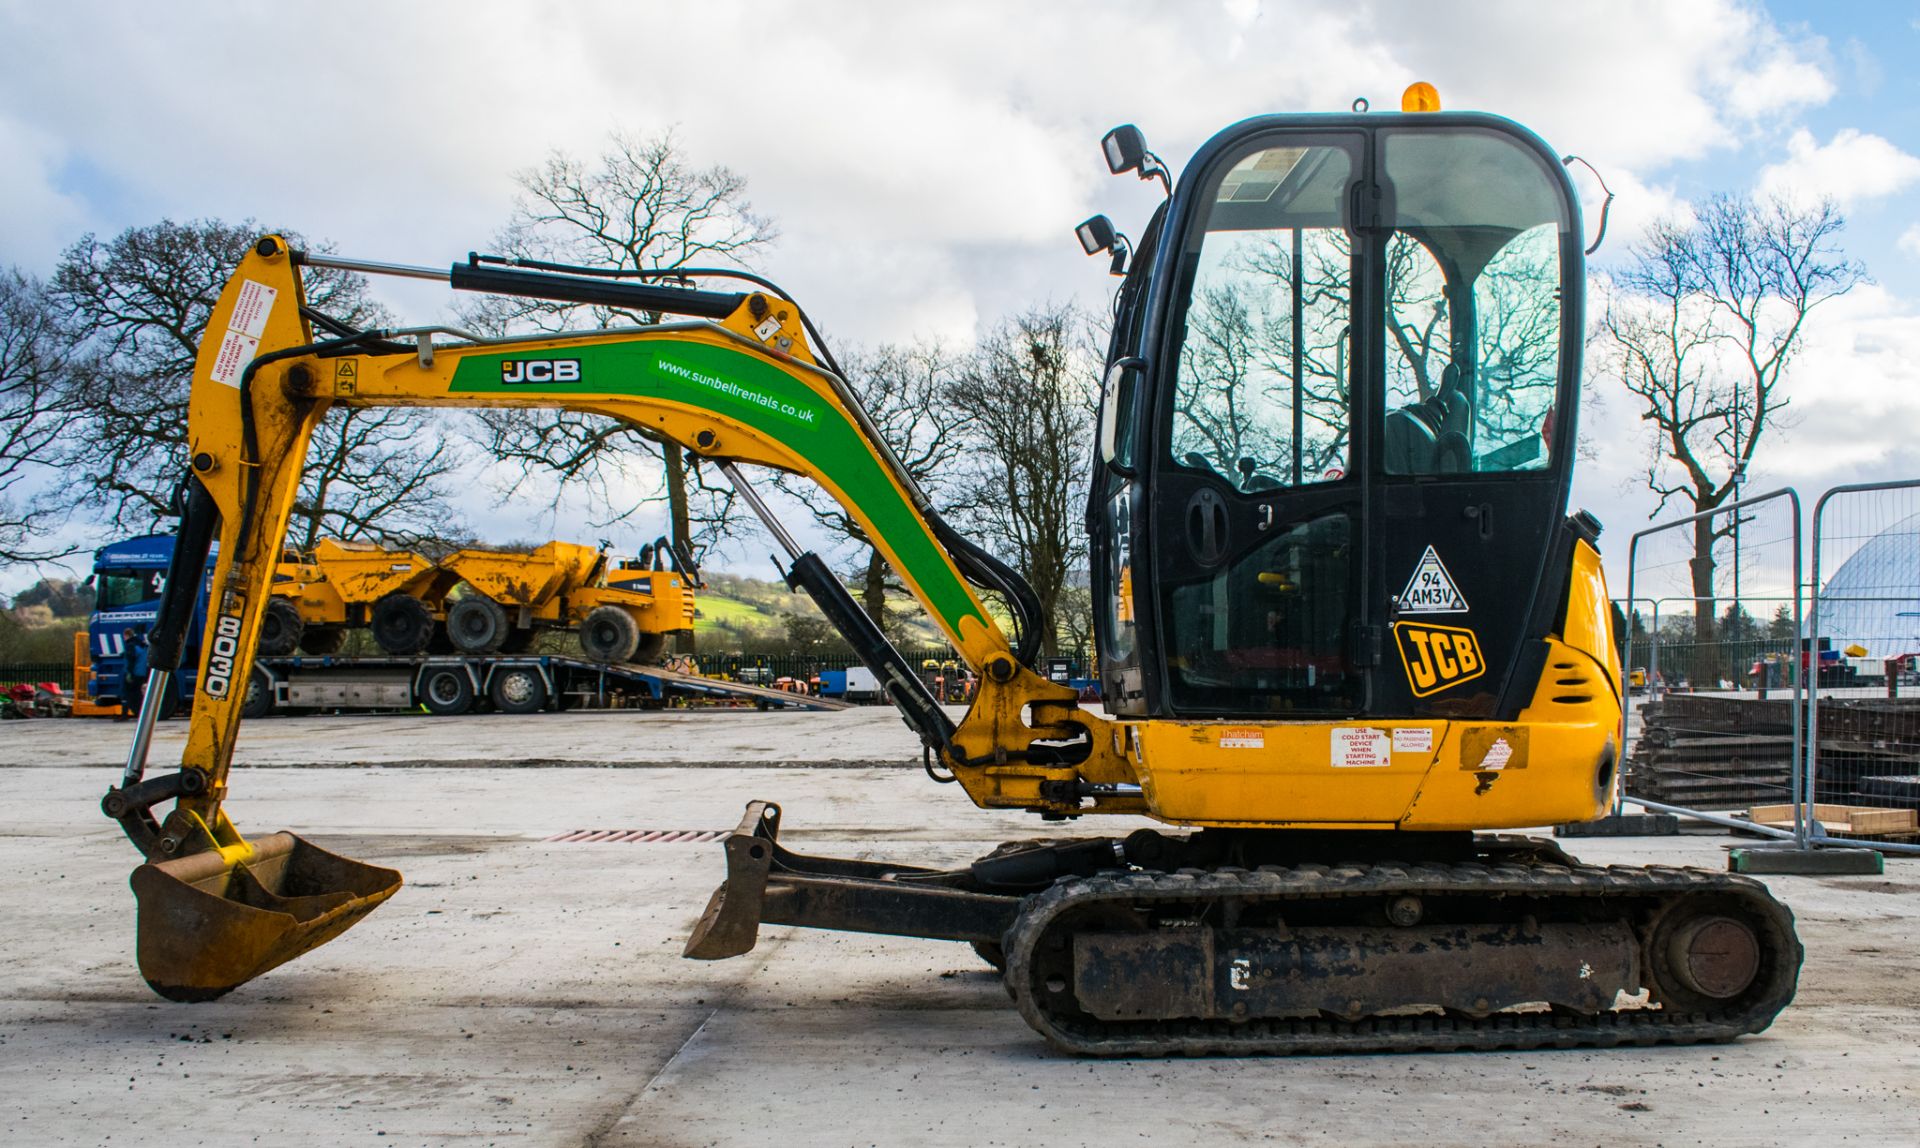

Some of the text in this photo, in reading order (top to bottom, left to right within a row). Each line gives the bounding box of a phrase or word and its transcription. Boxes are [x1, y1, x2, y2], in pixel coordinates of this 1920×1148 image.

[225, 334, 239, 367] EXCAVATOR
[228, 368, 234, 376] AS
[234, 344, 242, 363] CRANE
[216, 364, 222, 373] DO
[503, 360, 580, 382] JCB
[658, 359, 814, 423] www.sunbeltrentals.co.uk
[1422, 572, 1441, 587] 94
[1412, 588, 1452, 604] AM3V
[206, 616, 241, 697] 8030
[1407, 629, 1478, 688] JCB
[1222, 729, 1263, 739] Thatcham
